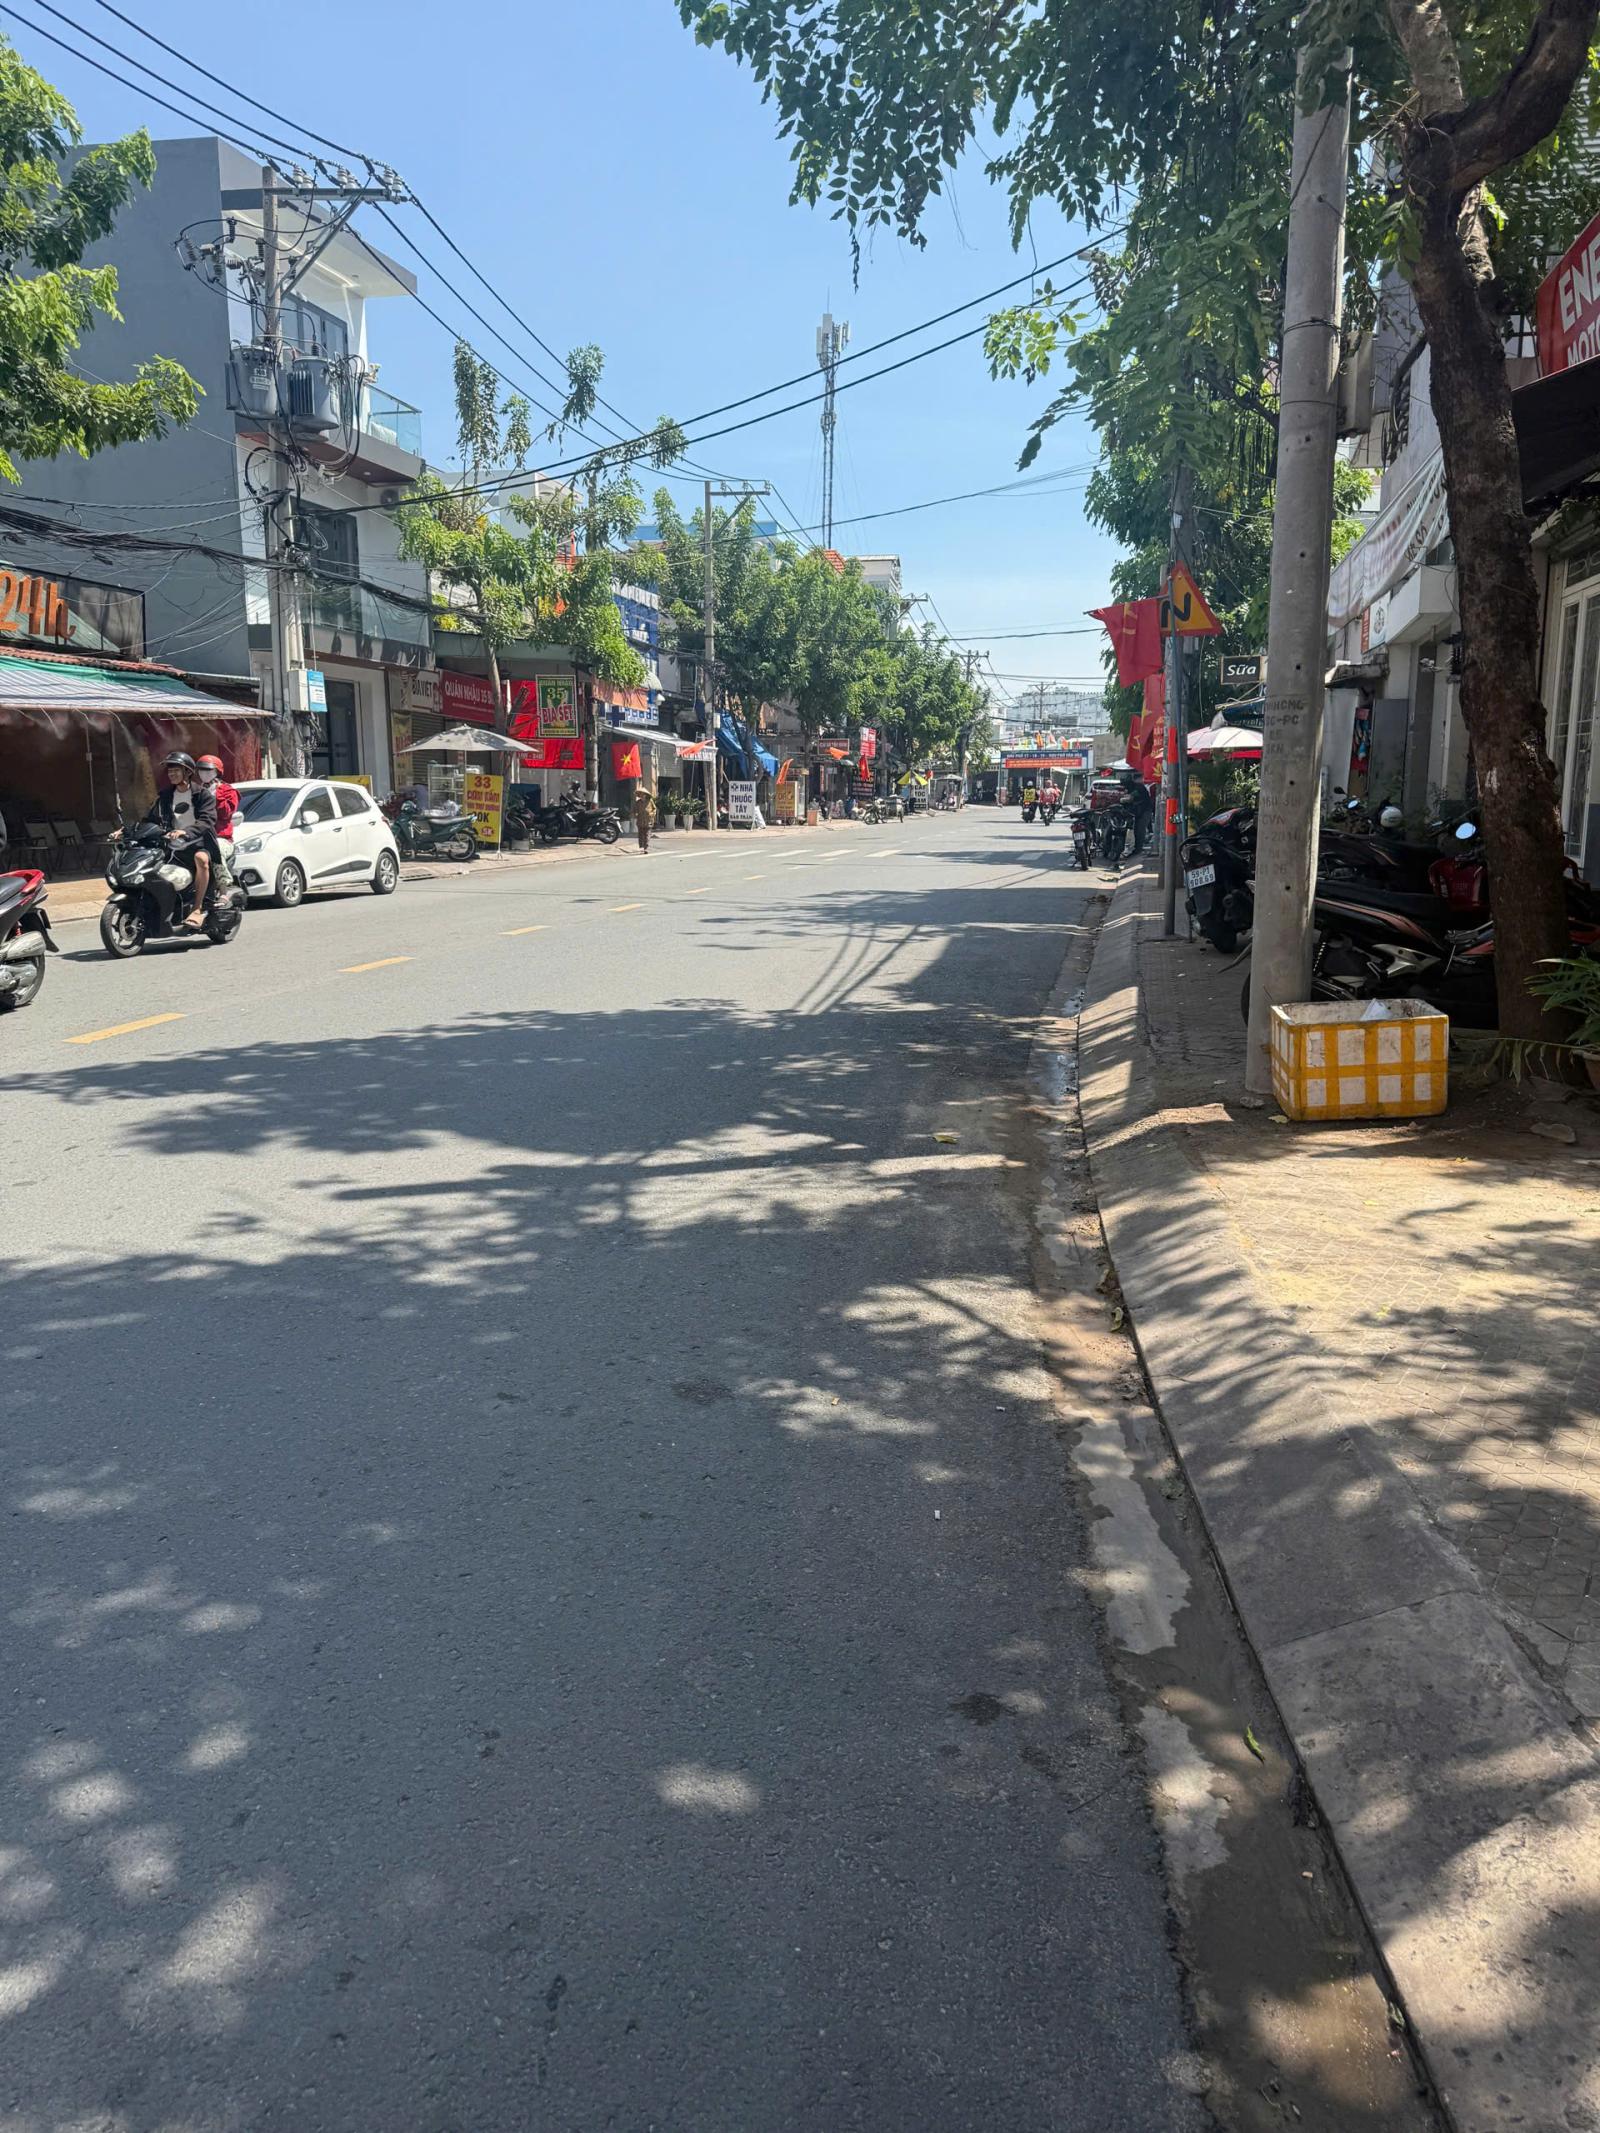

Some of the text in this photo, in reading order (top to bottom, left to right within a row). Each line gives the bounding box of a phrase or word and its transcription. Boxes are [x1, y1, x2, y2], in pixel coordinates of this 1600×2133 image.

[1226, 664, 1257, 676] Sữa
[444, 680, 462, 698] QUÁN
[463, 683, 481, 705] NHẬU
[547, 688, 565, 700] 35
[542, 708, 557, 723] BIA
[474, 776, 491, 789] 33
[731, 794, 752, 803] THUỐC
[735, 804, 747, 813] TÂY
